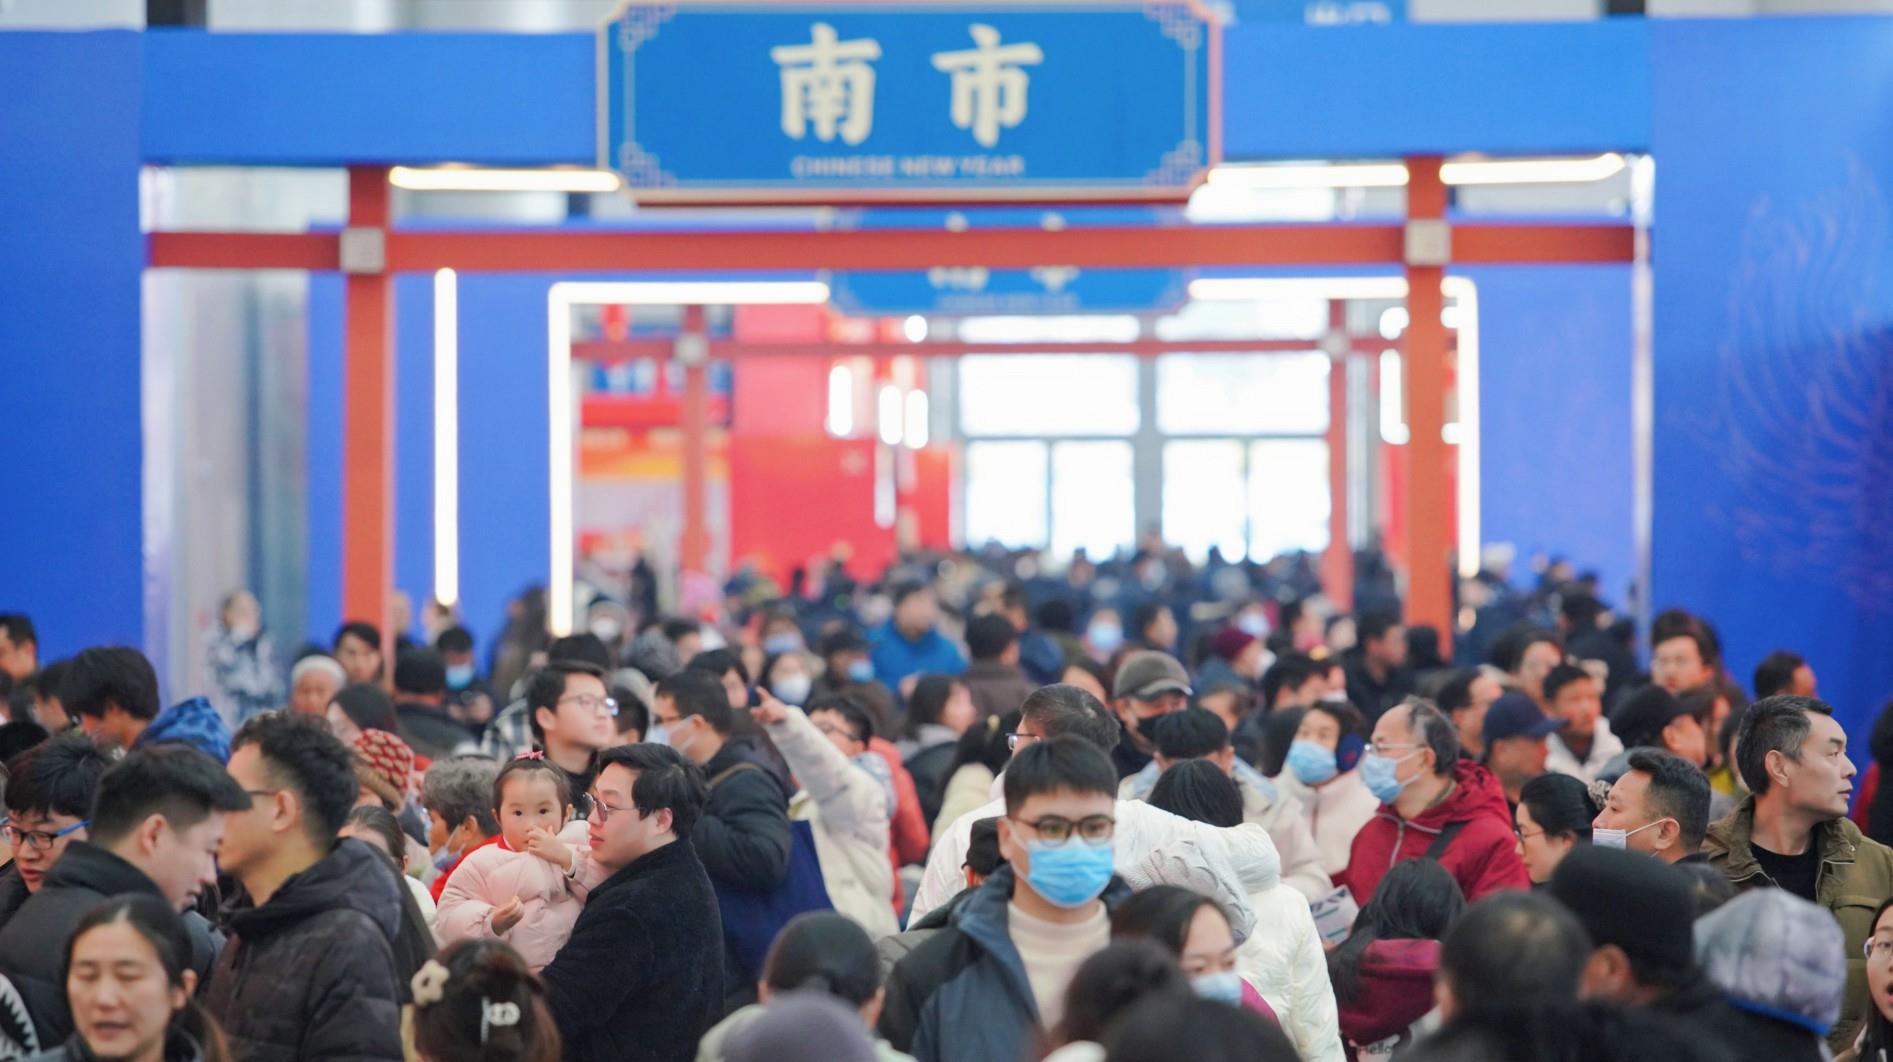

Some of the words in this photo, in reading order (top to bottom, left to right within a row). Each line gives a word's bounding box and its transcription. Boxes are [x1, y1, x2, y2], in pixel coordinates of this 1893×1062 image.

[770, 22, 1044, 147] 南市
[791, 155, 894, 176] CHINESE
[899, 155, 956, 175] NEW
[959, 155, 1025, 175] YEAR
